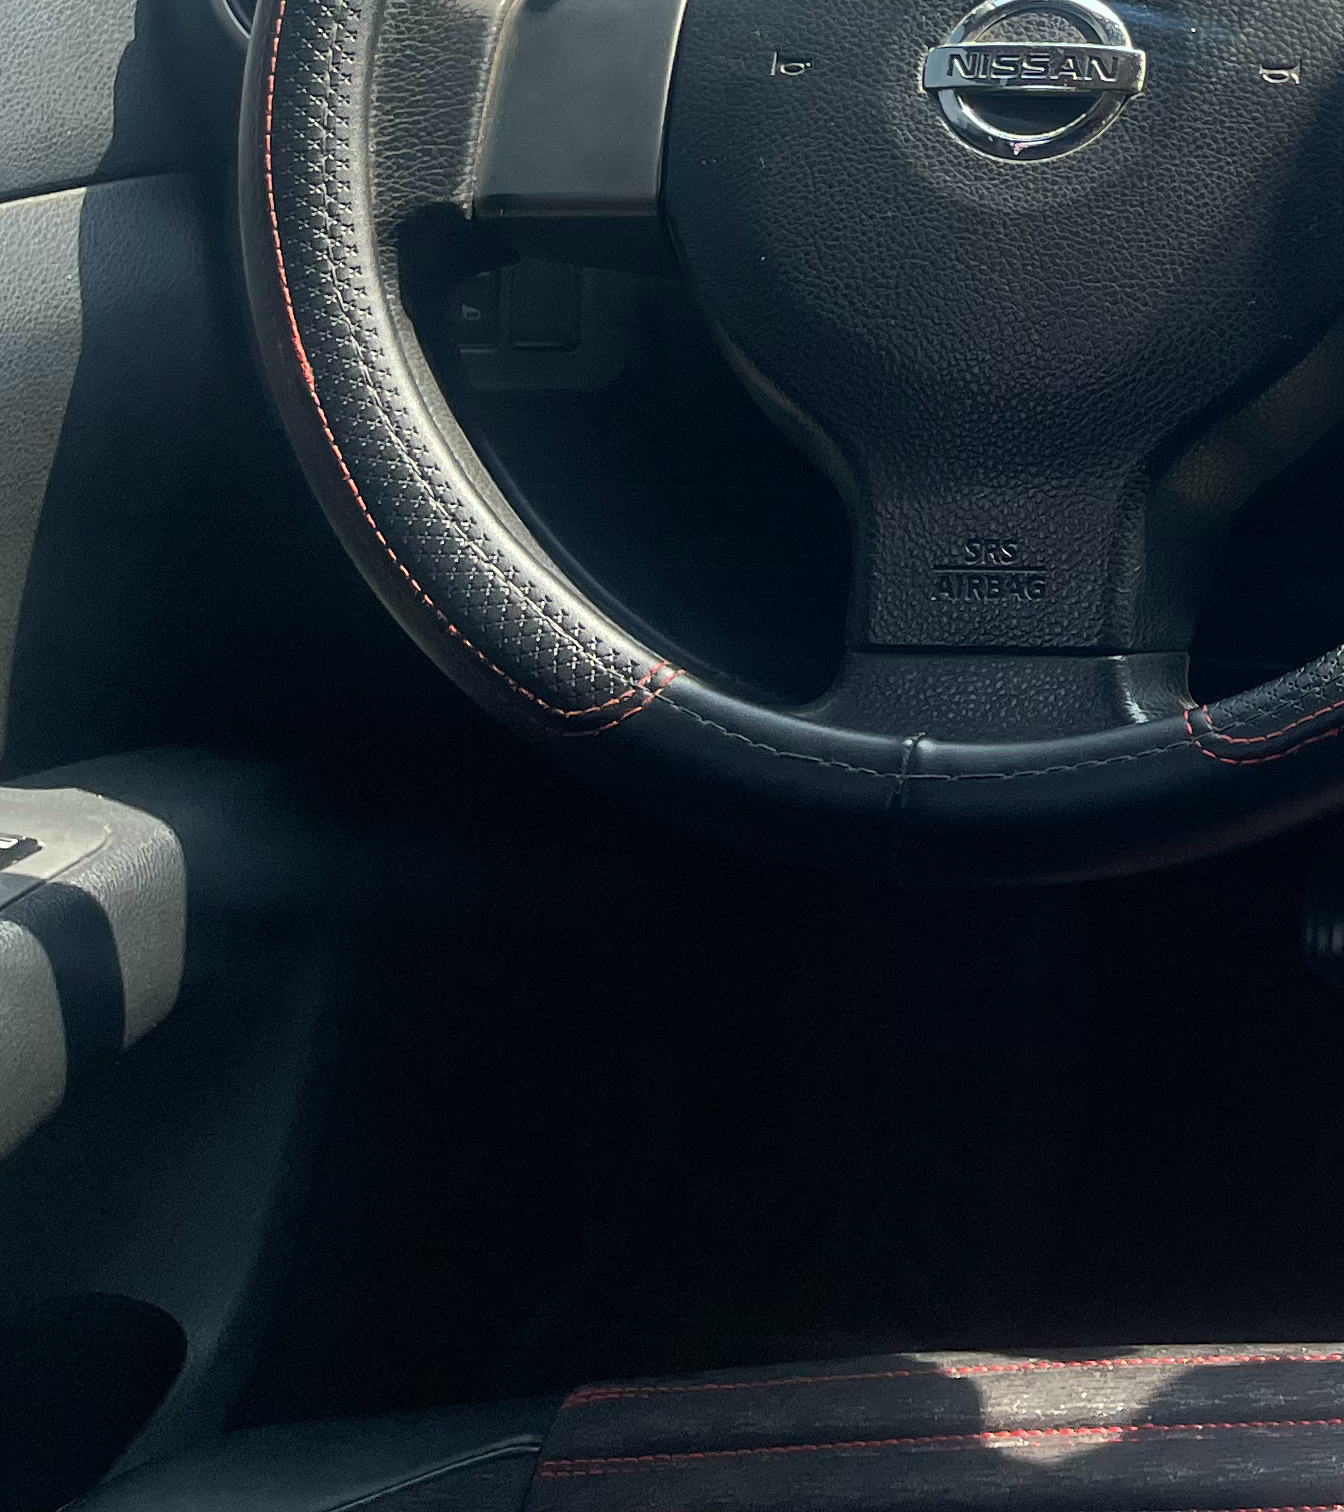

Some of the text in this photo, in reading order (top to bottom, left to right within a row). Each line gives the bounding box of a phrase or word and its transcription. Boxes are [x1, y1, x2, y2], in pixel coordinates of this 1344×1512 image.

[946, 52, 1120, 83] NISSAN
[962, 537, 1023, 566] SRS
[930, 575, 1047, 602] AIRBAG
